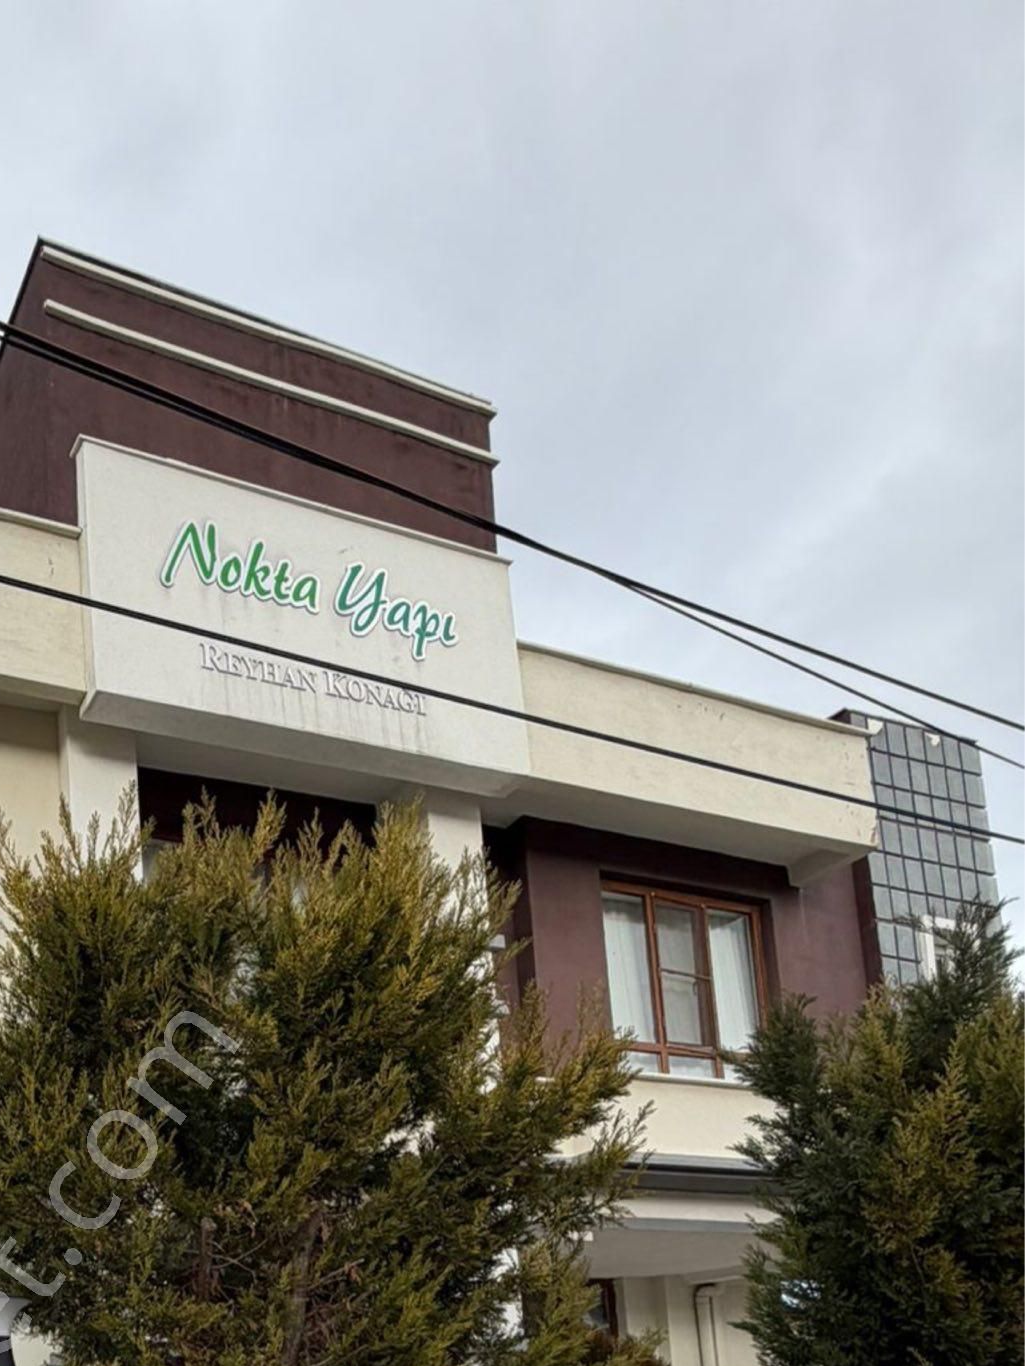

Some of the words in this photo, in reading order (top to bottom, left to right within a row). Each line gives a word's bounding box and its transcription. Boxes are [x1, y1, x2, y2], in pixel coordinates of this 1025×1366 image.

[161, 519, 320, 613] Nokta
[334, 560, 458, 660] Yapı
[199, 642, 317, 694] REYHAN
